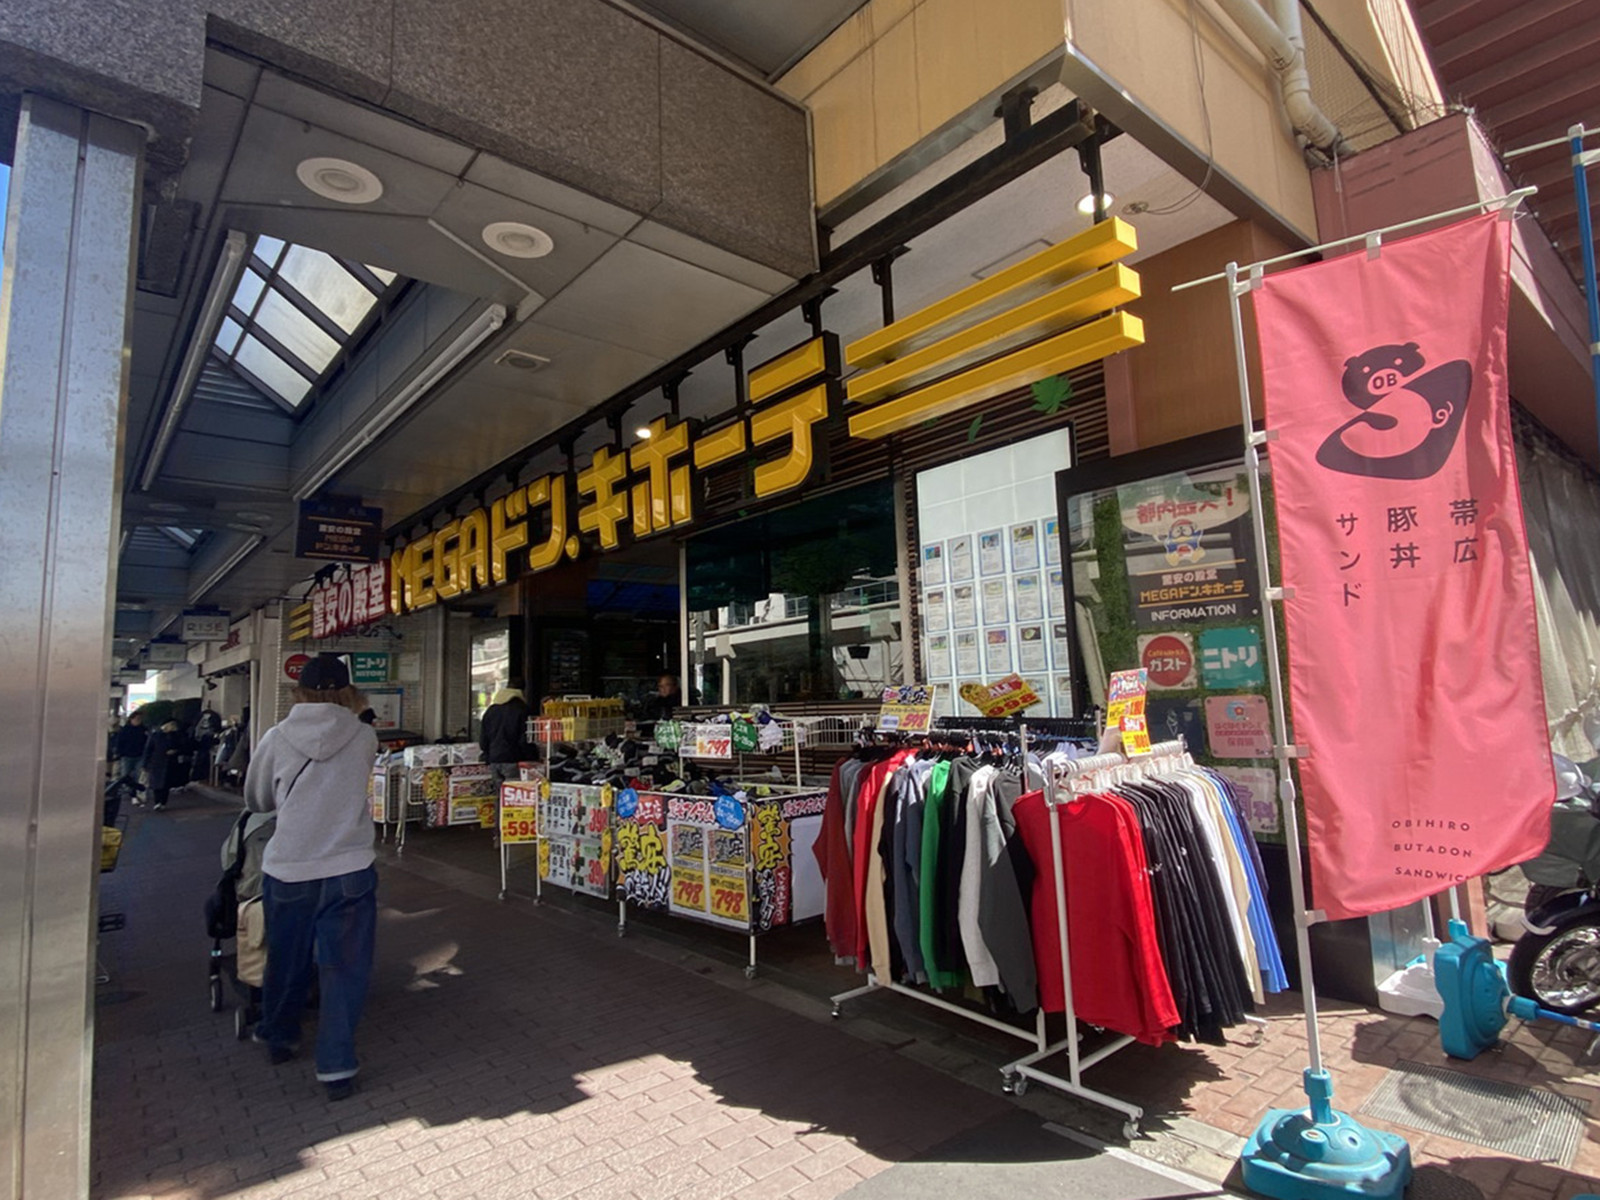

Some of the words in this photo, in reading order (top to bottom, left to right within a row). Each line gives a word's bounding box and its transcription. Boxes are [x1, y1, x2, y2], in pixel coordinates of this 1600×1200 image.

[1373, 373, 1398, 390] OB
[1387, 506, 1421, 569] 豚丼
[1449, 498, 1479, 564] 帯広
[1336, 512, 1362, 607] サンド
[1151, 604, 1237, 622] INFORMATION
[356, 657, 387, 669] ニトリ
[1150, 658, 1187, 672] ガスト
[1203, 645, 1258, 670] ニトリ
[902, 712, 928, 728] 598
[707, 739, 730, 755] 798
[504, 787, 536, 801] SALE
[1391, 819, 1470, 832] OBIHIRO
[1394, 843, 1472, 858] BUTADON
[678, 881, 703, 904] 798
[715, 889, 744, 914] 798
